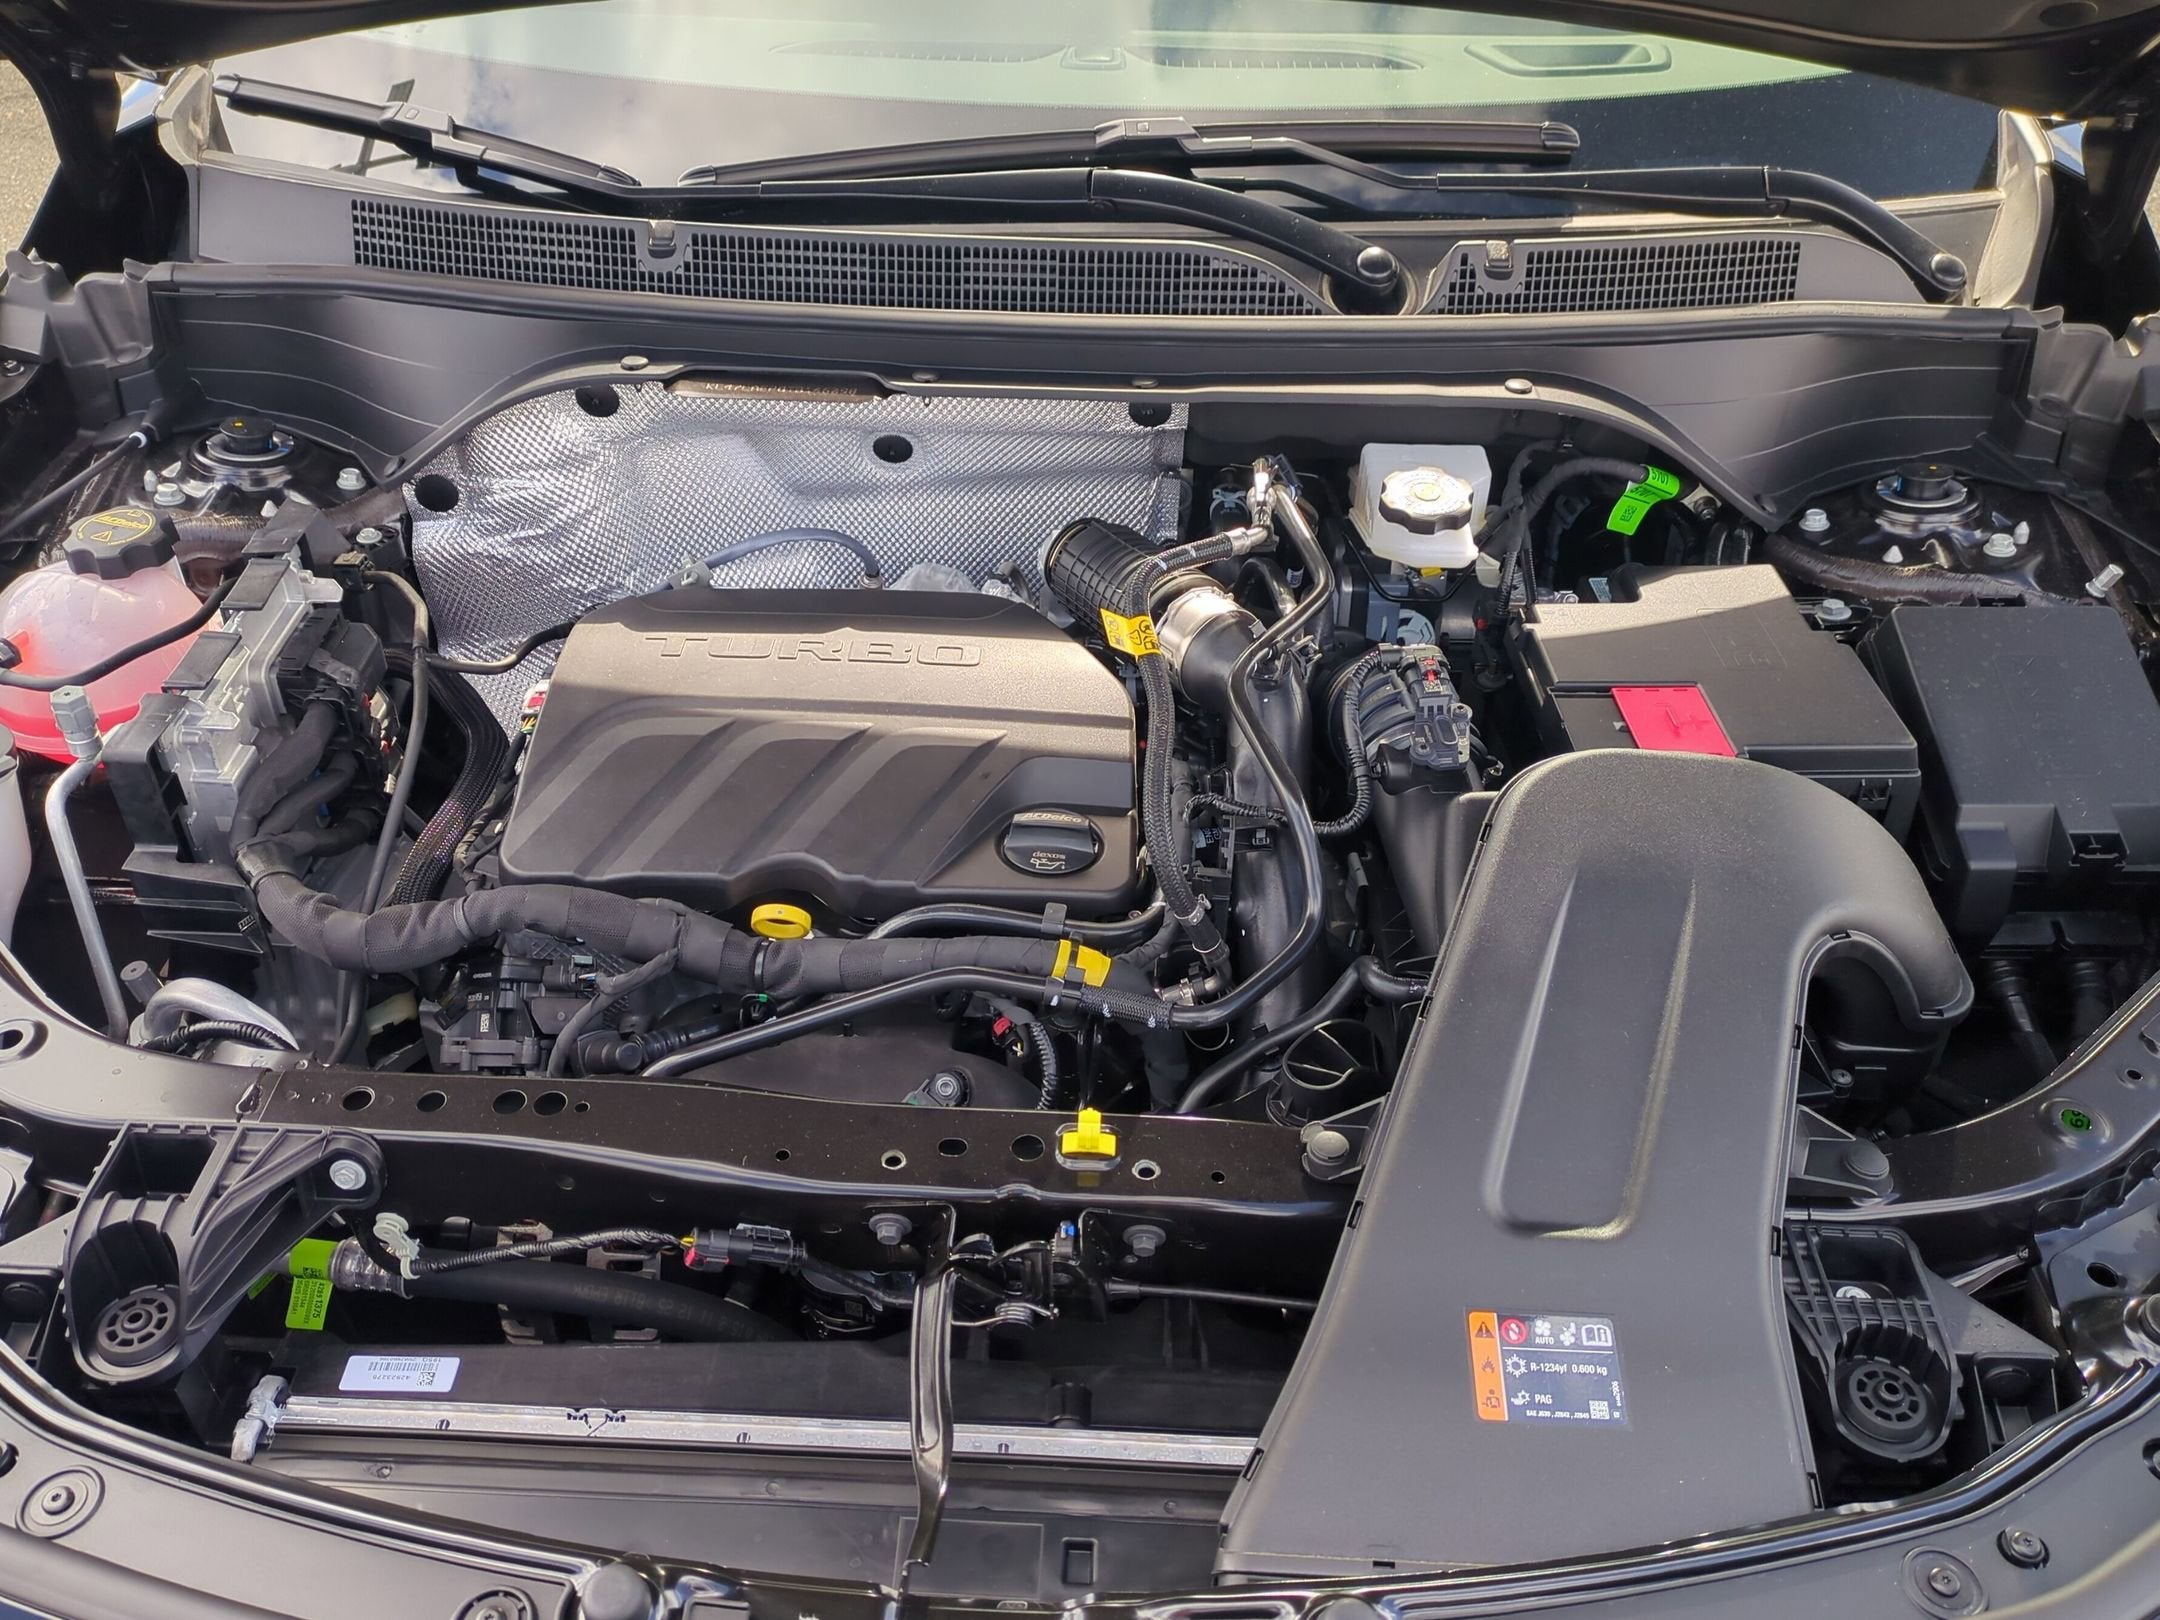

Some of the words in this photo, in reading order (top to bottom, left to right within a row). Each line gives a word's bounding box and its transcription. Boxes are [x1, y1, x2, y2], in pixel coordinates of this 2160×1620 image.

[645, 637, 982, 667] TURBO
[1023, 812, 1082, 823] ACDelco
[1032, 851, 1066, 859] dexos
[1535, 1336, 1554, 1345] AUTO
[1530, 1362, 1568, 1374] R-1234yf
[1571, 1364, 1595, 1374] 0.600
[1596, 1365, 1608, 1376] kg
[1534, 1393, 1552, 1405] PAG
